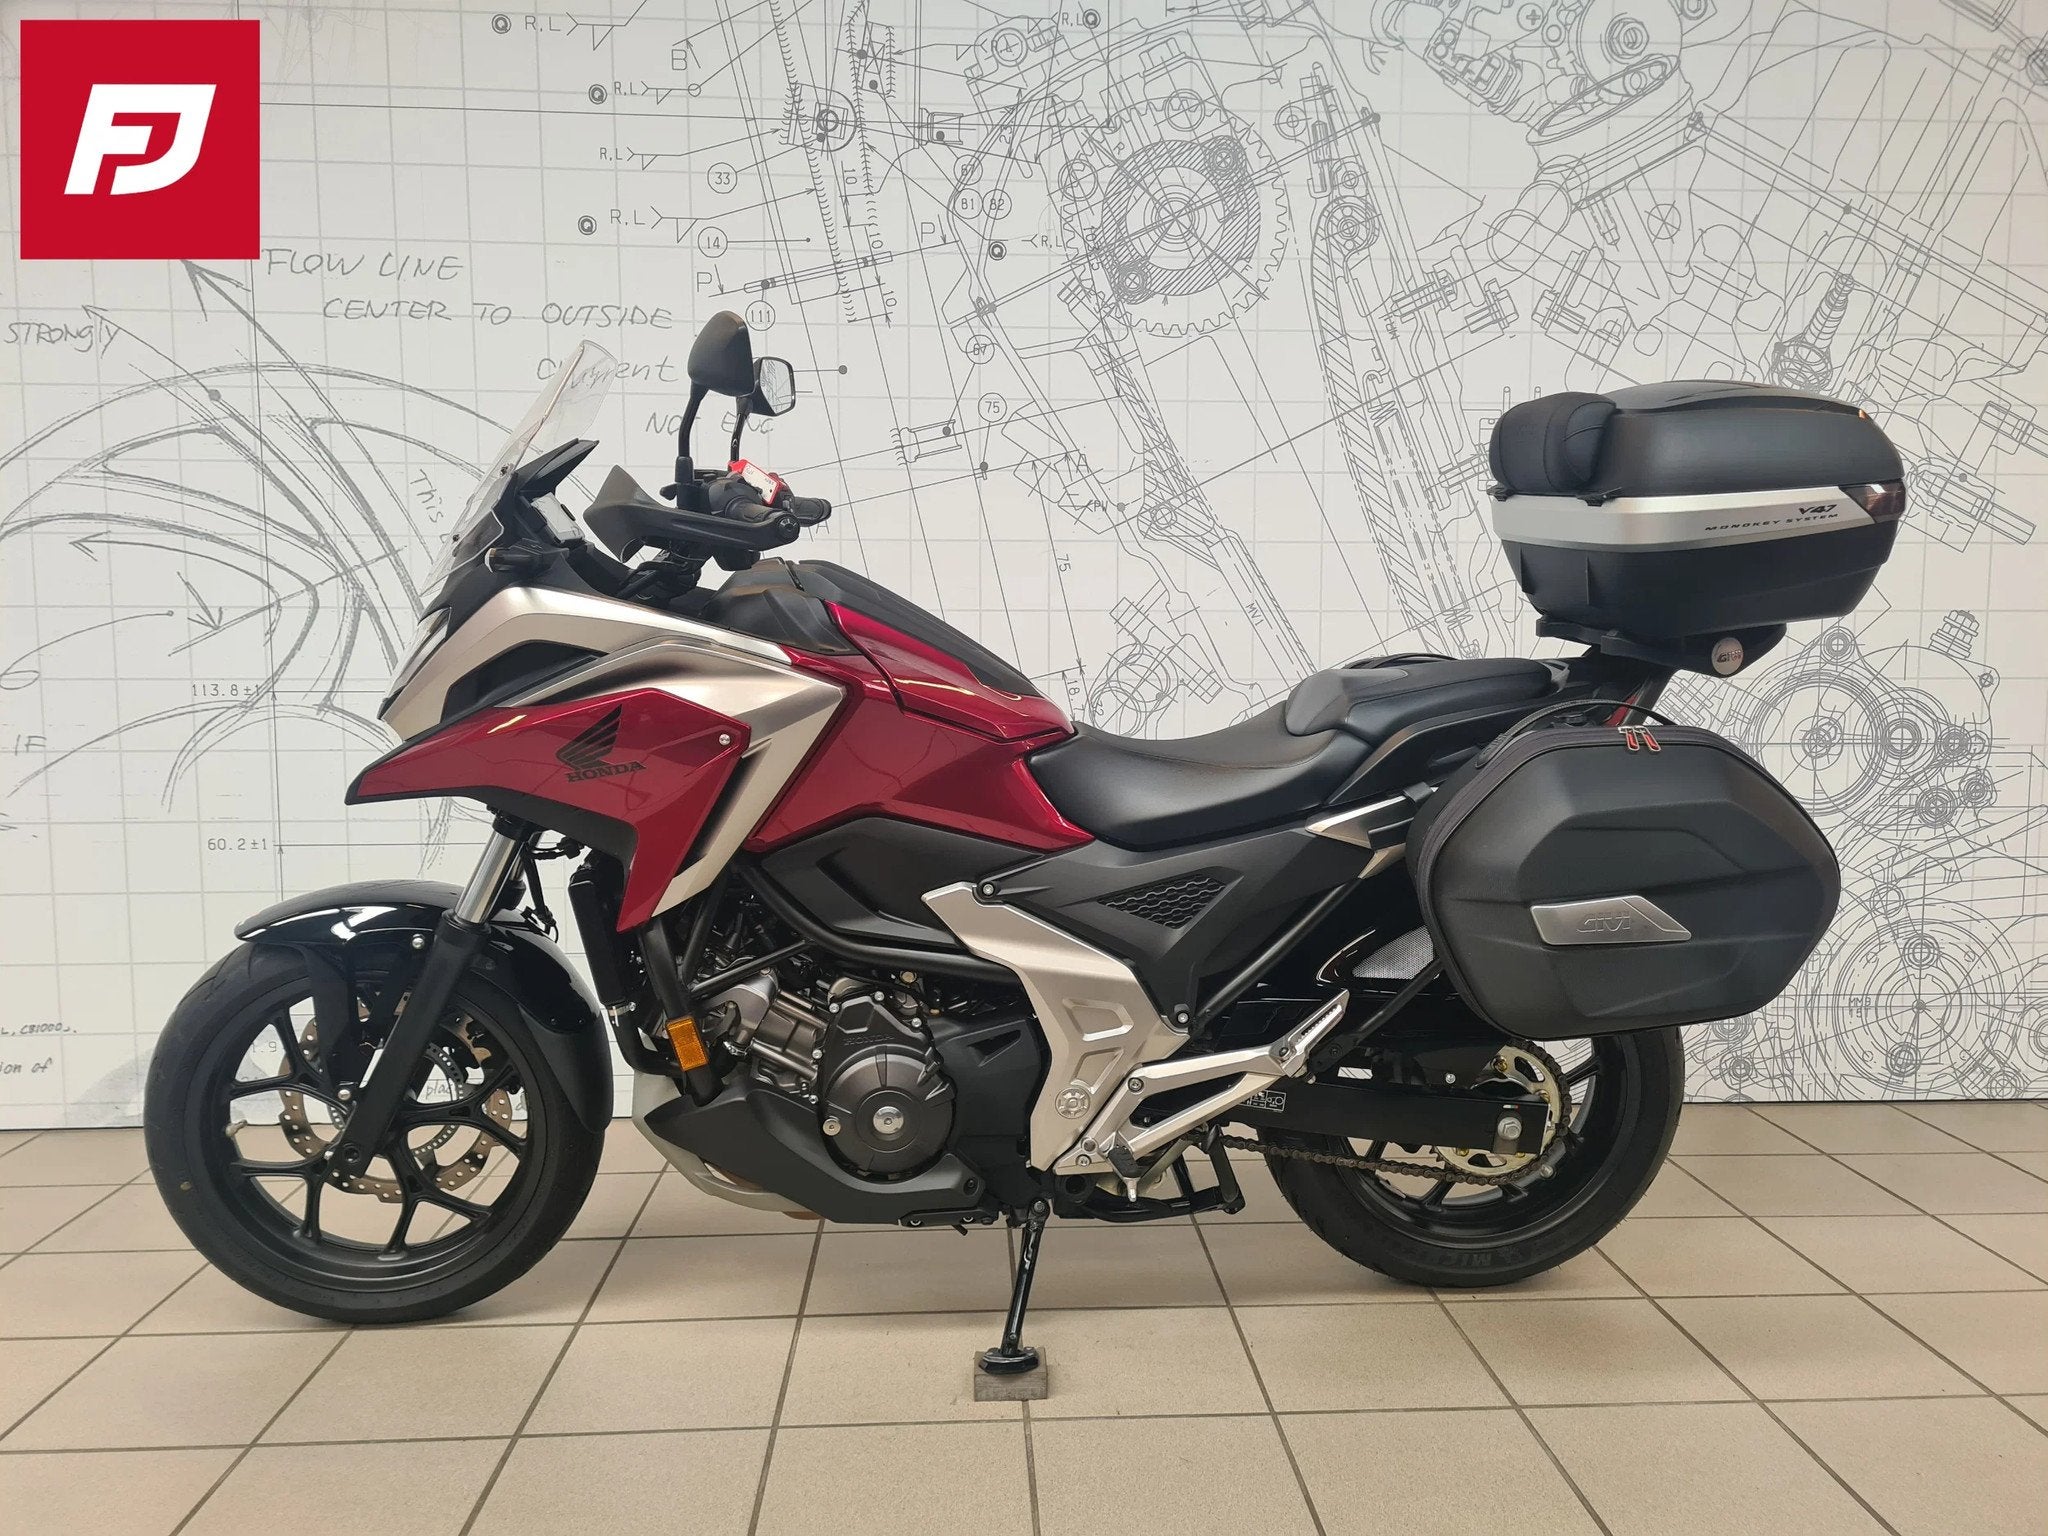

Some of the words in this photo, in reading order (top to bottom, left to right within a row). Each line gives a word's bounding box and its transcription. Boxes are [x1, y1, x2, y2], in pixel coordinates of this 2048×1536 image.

[672, 49, 688, 70] B
[714, 171, 731, 185] 33
[961, 197, 974, 210] 81
[707, 236, 721, 249] 14
[262, 248, 365, 276] FLOW
[378, 252, 465, 281] LINE
[697, 272, 713, 292] P
[323, 298, 453, 322] CENTER
[471, 302, 513, 326] TO
[541, 302, 673, 330] OUTSIDE
[985, 401, 1000, 413] 75
[1704, 520, 1781, 531] MONOKEY
[1785, 513, 1839, 524] SYSTEM
[565, 761, 647, 783] HONDA
